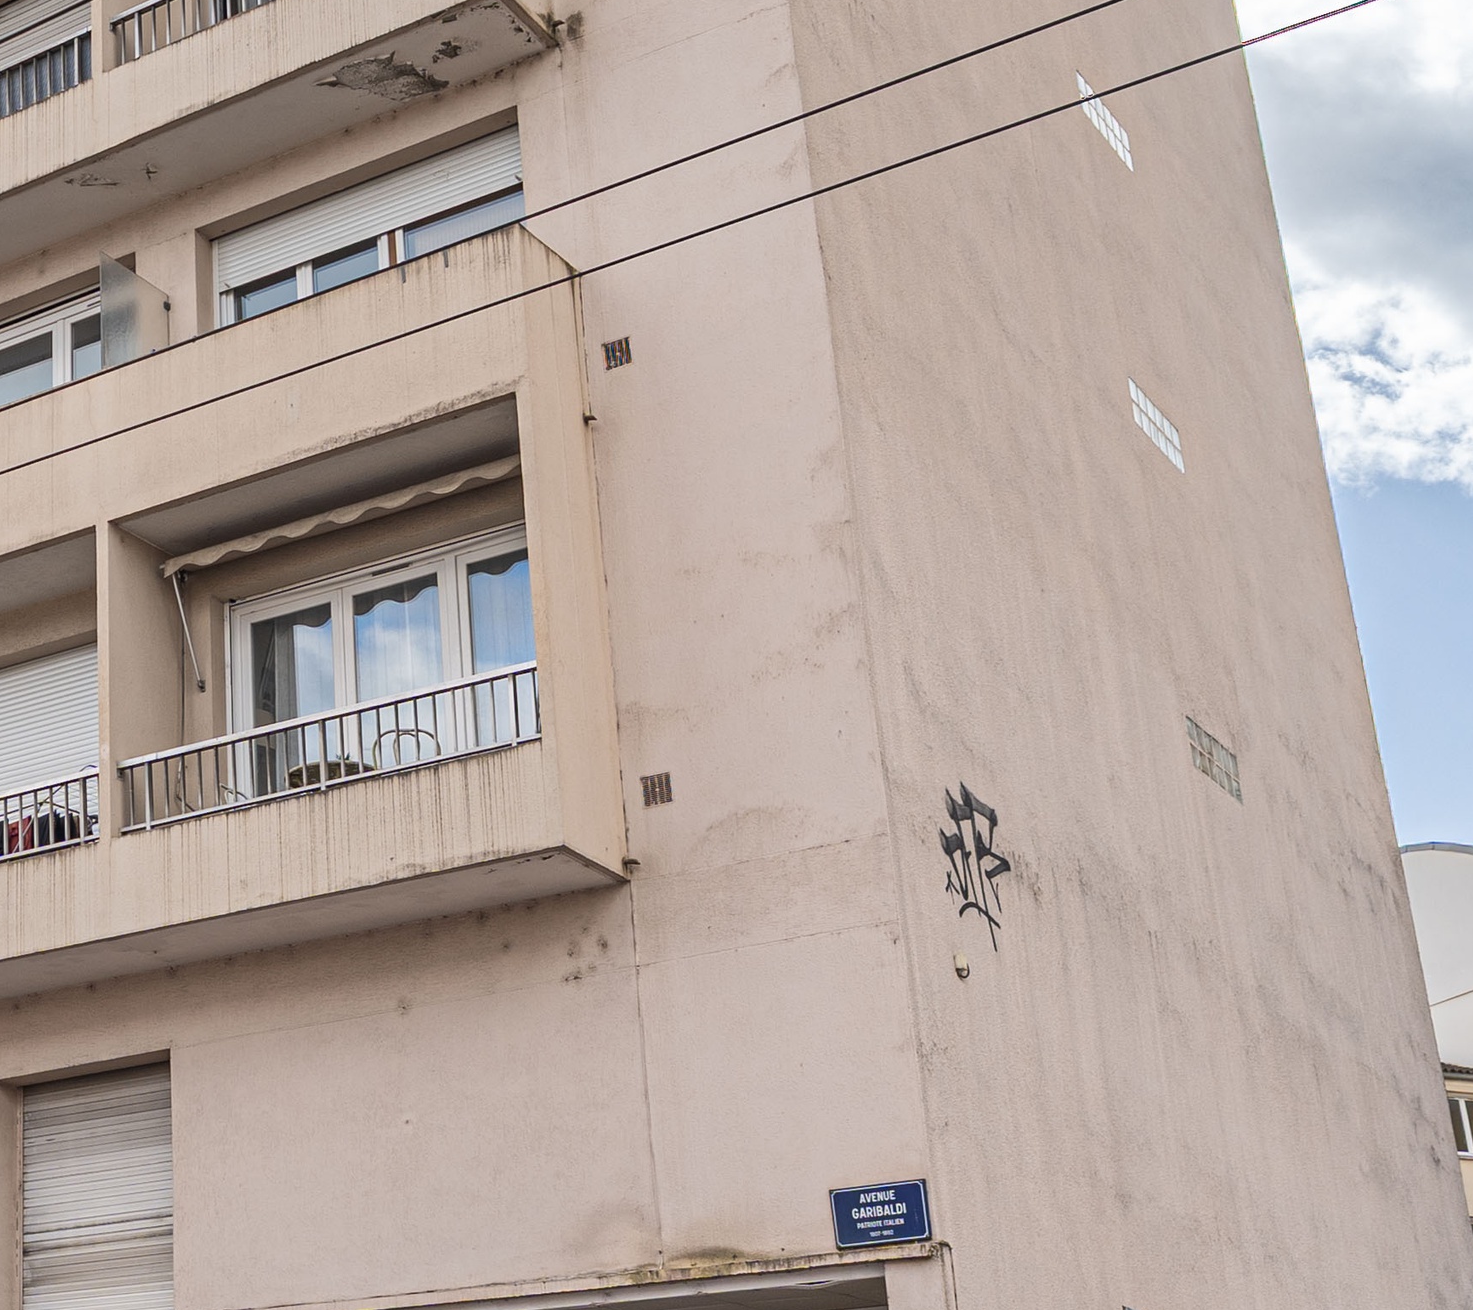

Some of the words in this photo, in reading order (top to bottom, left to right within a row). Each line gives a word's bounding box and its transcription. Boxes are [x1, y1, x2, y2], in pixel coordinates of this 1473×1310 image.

[859, 1190, 896, 1204] AVENUE
[851, 1202, 907, 1219] GARIBALDI
[856, 1221, 883, 1230] PATRIOTE
[883, 1218, 905, 1227] ITALIEN
